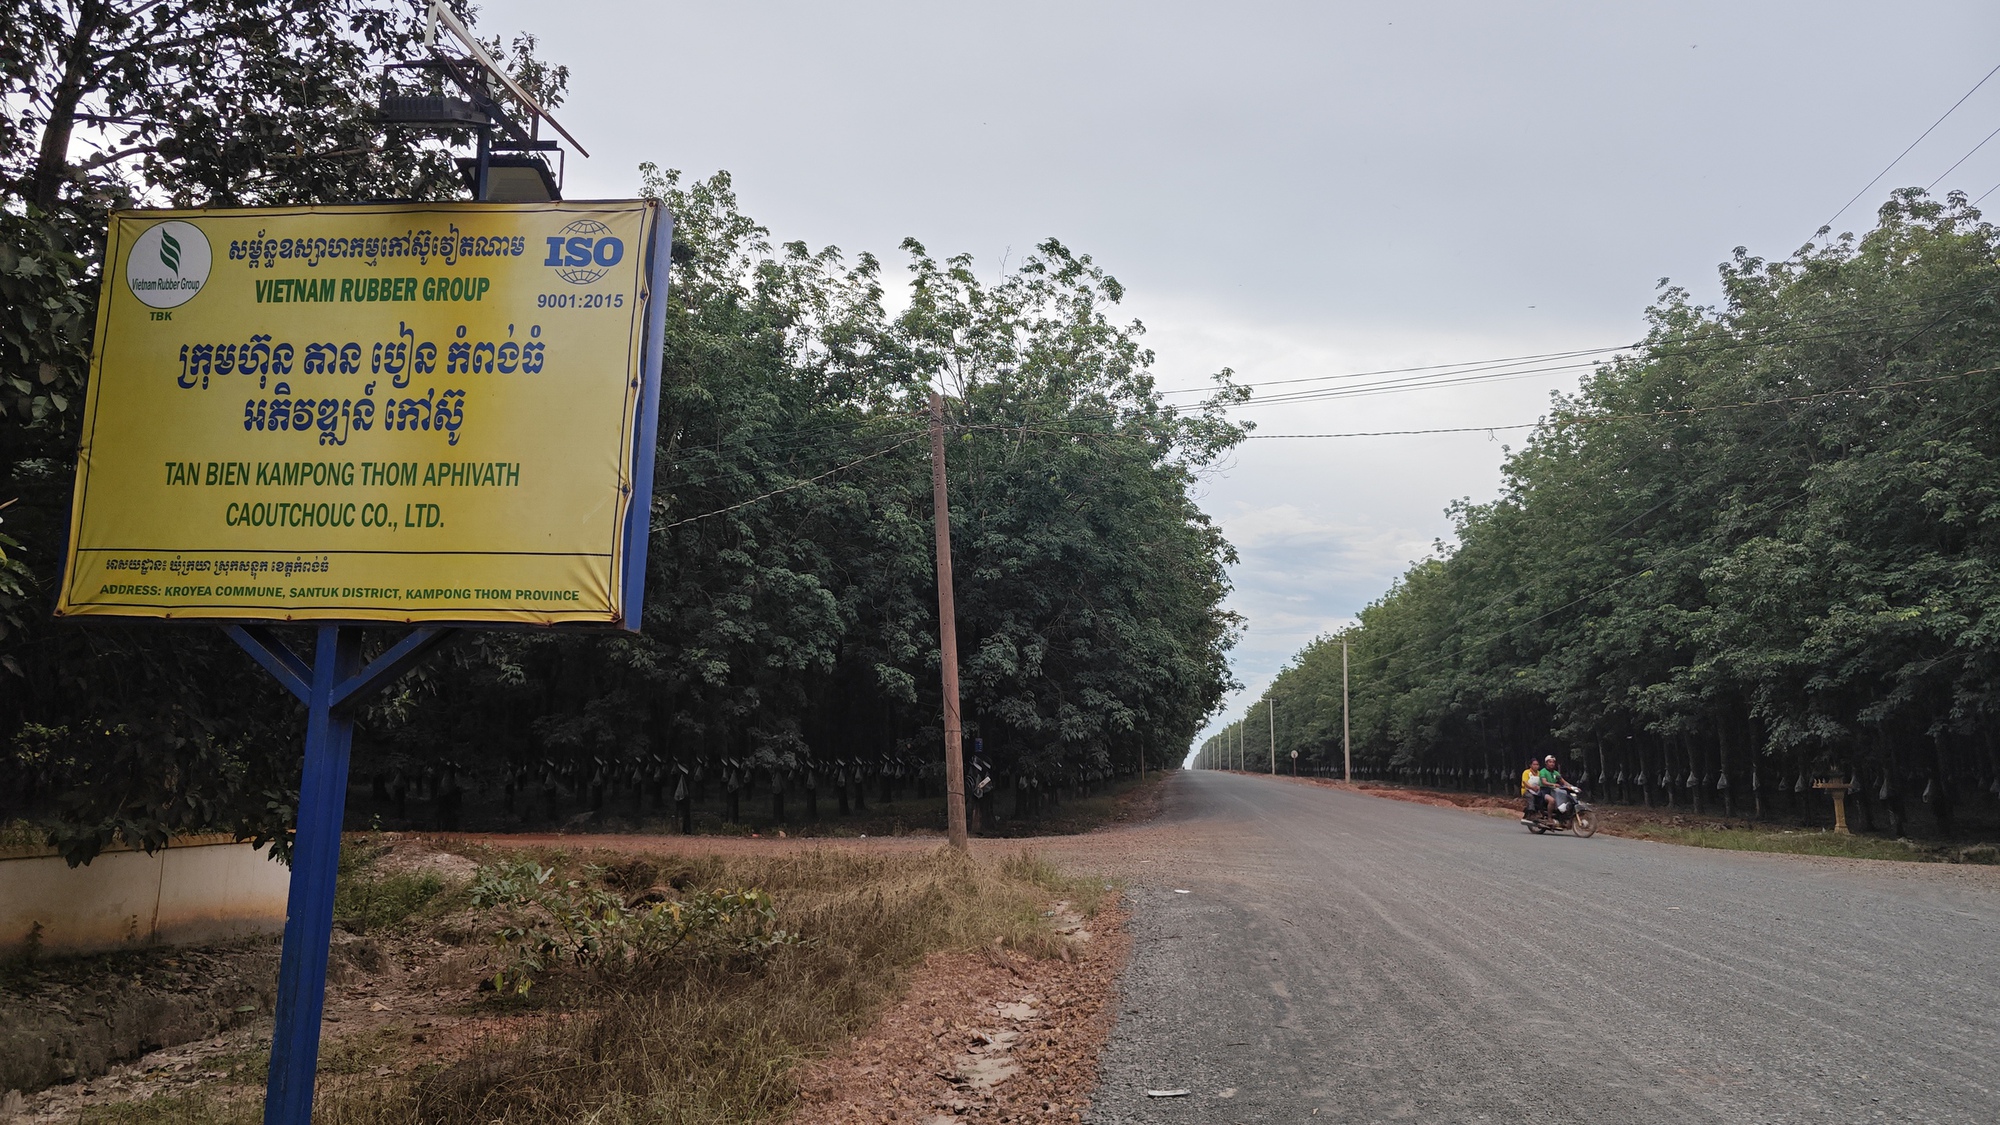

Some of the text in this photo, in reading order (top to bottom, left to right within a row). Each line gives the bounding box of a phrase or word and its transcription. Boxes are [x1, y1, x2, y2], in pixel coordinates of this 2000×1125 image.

[544, 237, 624, 267] ISO
[132, 277, 200, 292] Vietnam Rubber Group
[256, 277, 490, 303] VIETNAM RUBBER GROUP
[538, 294, 623, 308] 9001:2015
[150, 311, 173, 321] TBK
[177, 321, 545, 390] ក្រុមហ៊ុន តាន បៀន កំពង់ធំ
[385, 388, 467, 446] កៅស៊ូ
[165, 462, 519, 486] TAN BIEN KAMPONG THOM APHIVATH
[226, 503, 444, 532] CAOUTCHOUC CO., LTD.
[99, 585, 579, 600] ADDRESS: KROYEA COMMUNE, SANTUK DISTRICT, KAMPONG THOM PROVINCE
